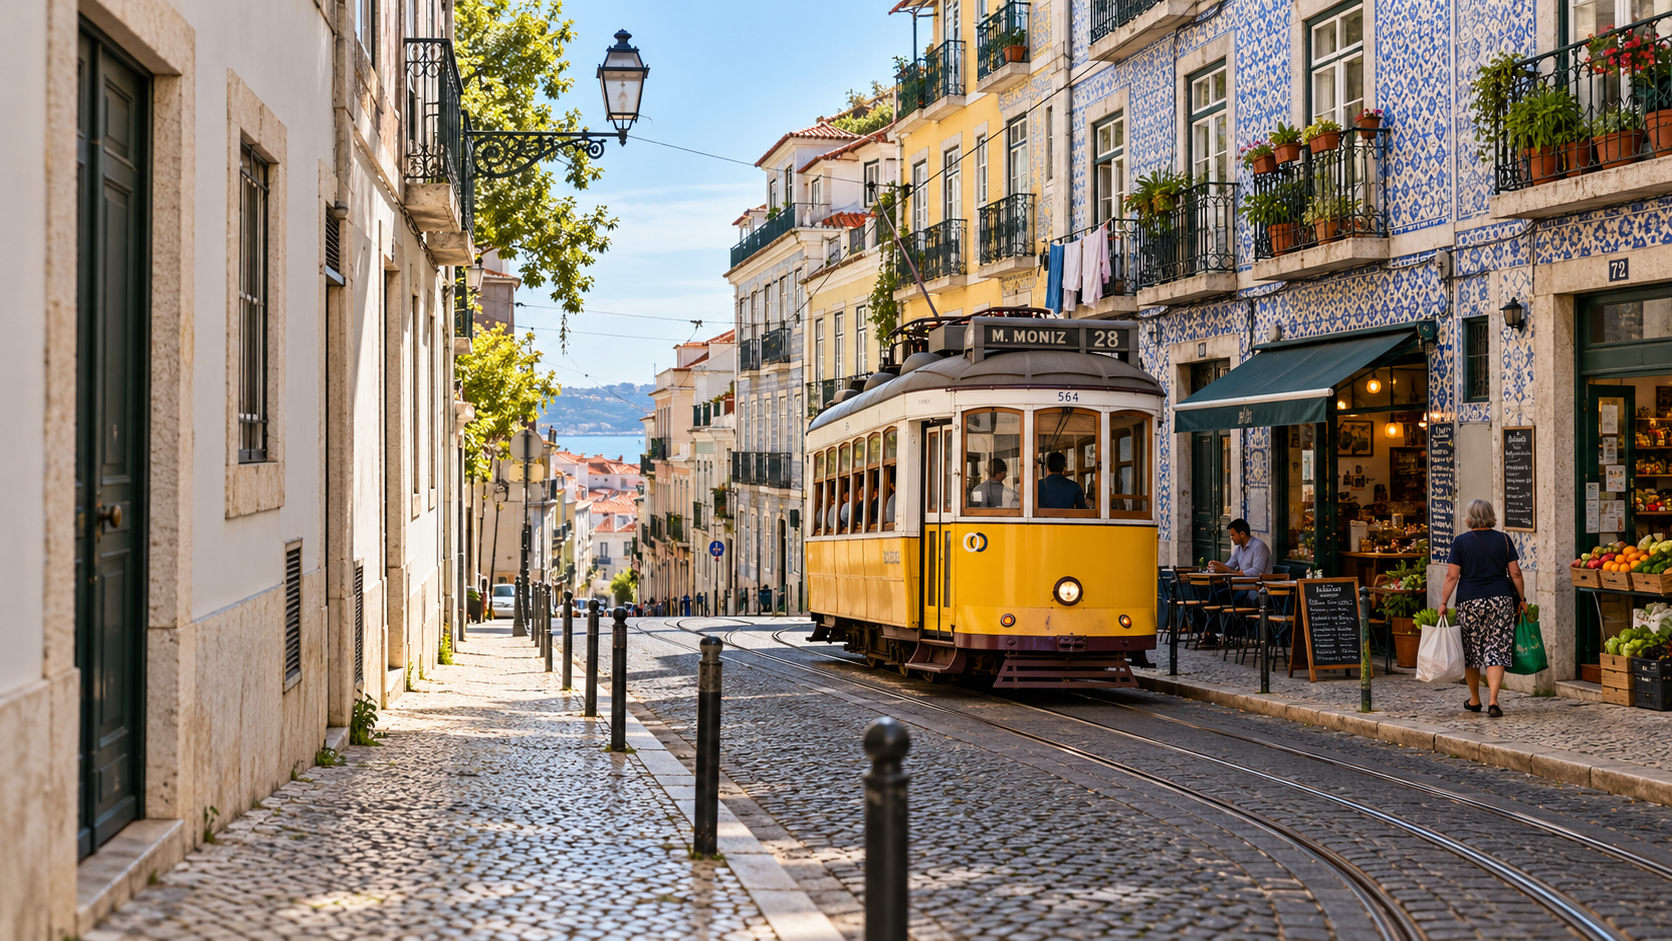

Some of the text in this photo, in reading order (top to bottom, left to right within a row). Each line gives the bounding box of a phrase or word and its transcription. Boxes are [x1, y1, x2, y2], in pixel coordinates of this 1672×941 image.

[1611, 261, 1626, 279] 72
[992, 329, 1066, 344] M. MONIZ
[1094, 330, 1119, 347] 28
[1058, 391, 1079, 402] 564
